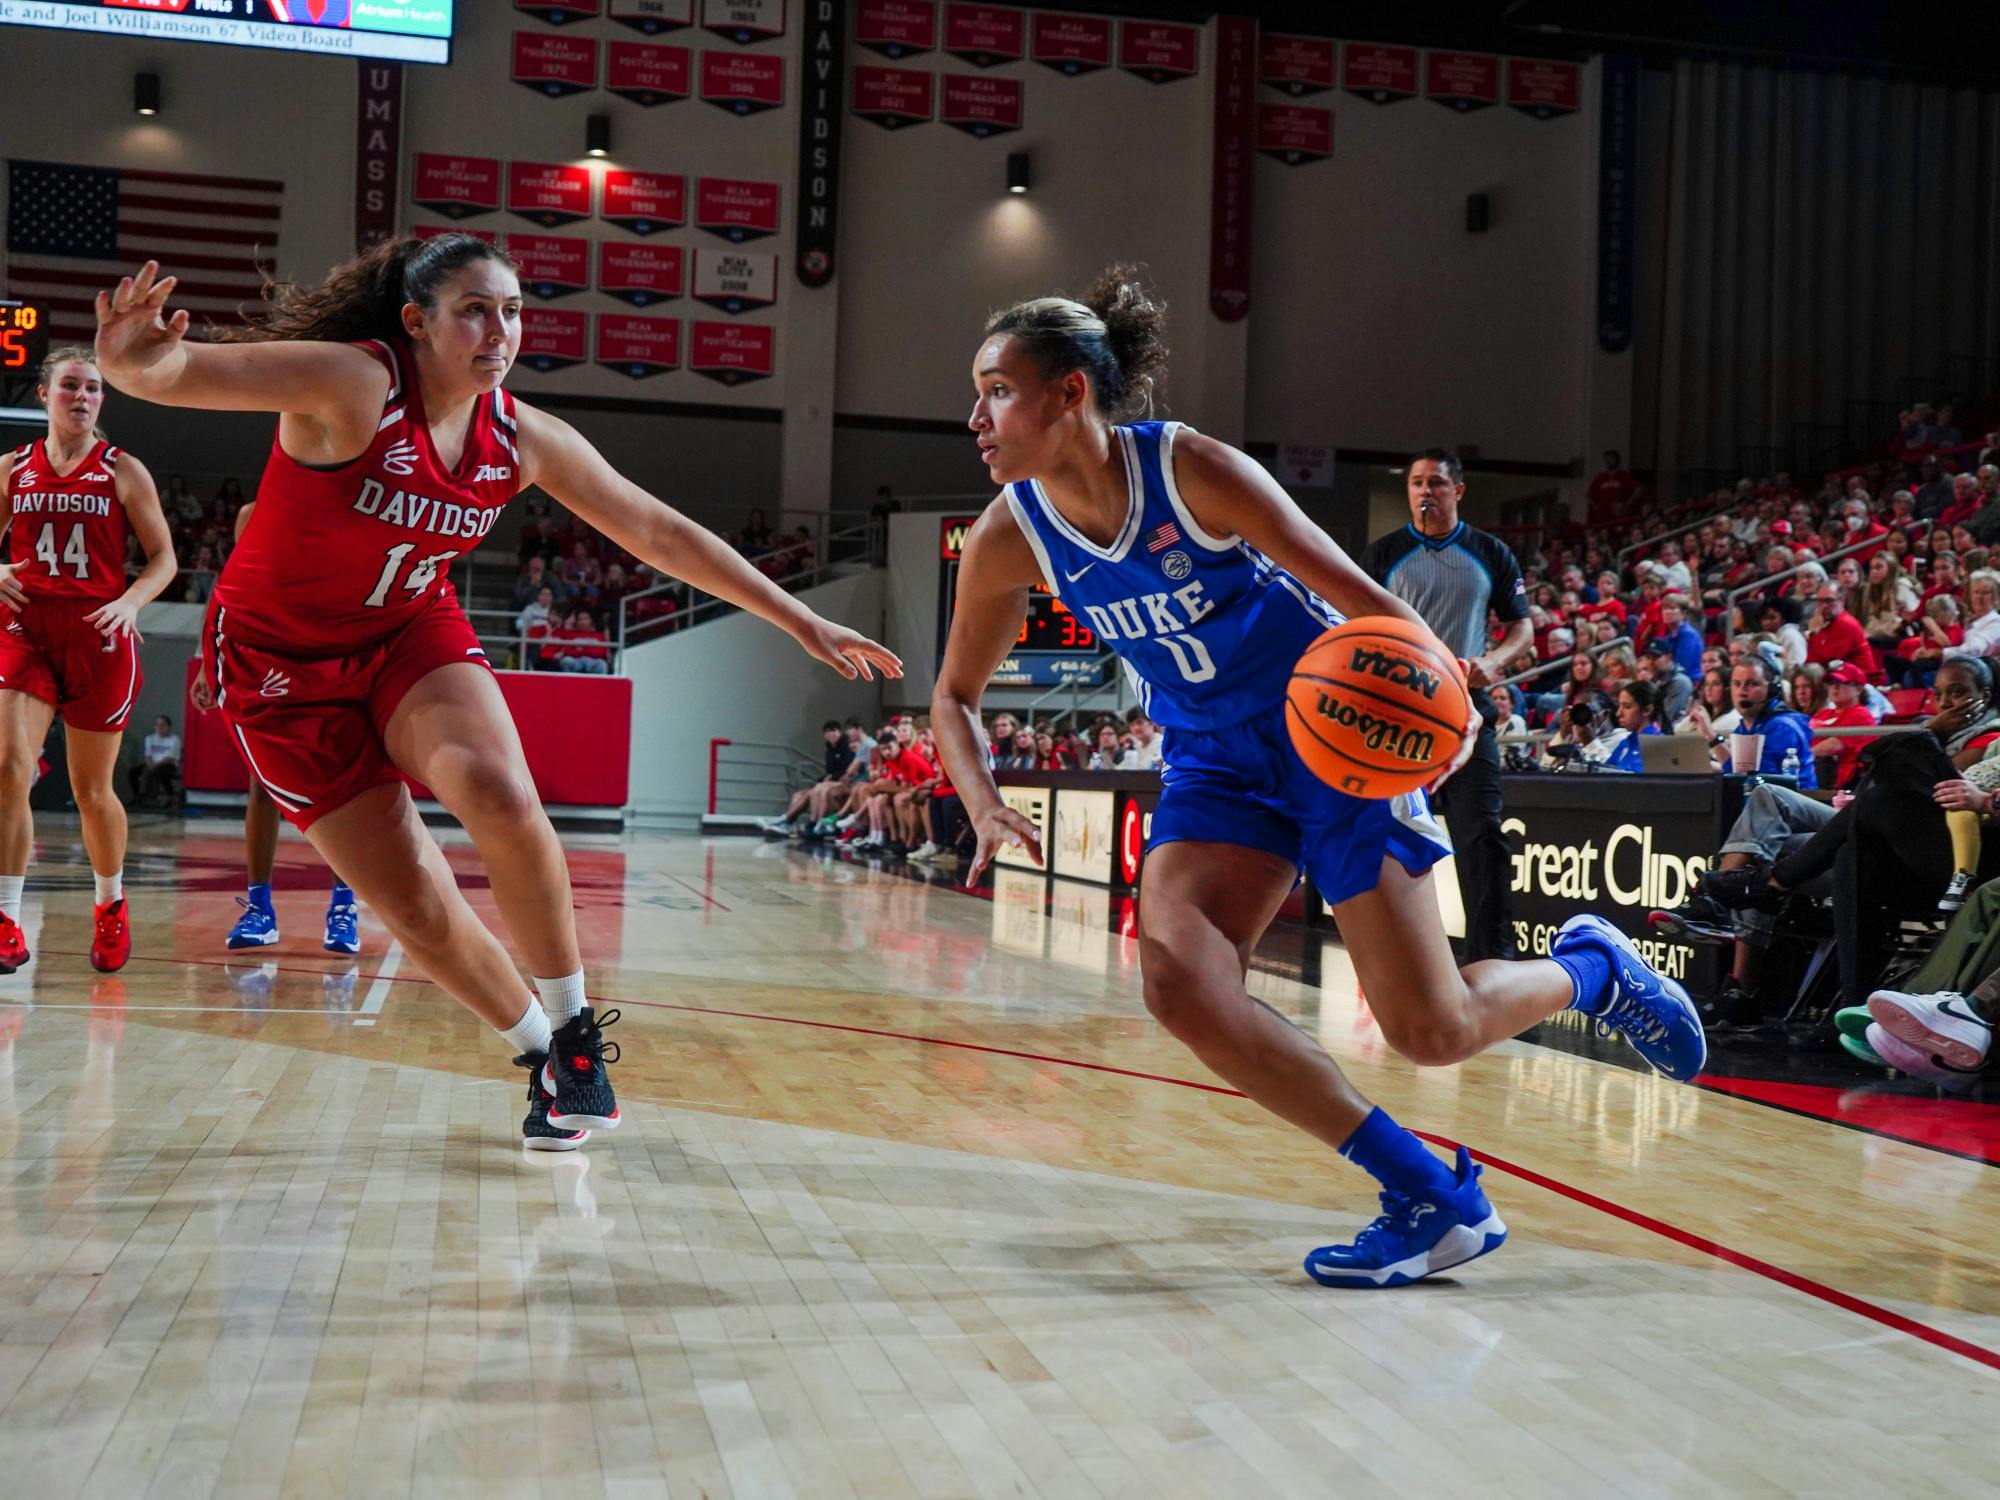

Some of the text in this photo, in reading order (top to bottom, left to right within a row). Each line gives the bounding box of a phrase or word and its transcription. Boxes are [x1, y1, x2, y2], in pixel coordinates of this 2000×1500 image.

[22, 7, 55, 21] and
[64, 9, 98, 25] Joel
[106, 12, 211, 36] Williamson
[246, 26, 298, 42] Video
[301, 31, 353, 49] Board
[356, 3, 403, 18] Atrium
[366, 69, 390, 212] UMASS
[809, 0, 833, 227] DAVIDSON
[0, 330, 26, 367] 5
[13, 493, 110, 517] DAVIDSON
[35, 522, 89, 578] 44
[363, 543, 460, 607] 14
[1083, 580, 1216, 641] DUKE
[1153, 634, 1217, 683] 0
[1350, 647, 1440, 700] NCAA
[1316, 691, 1436, 762] Wilson
